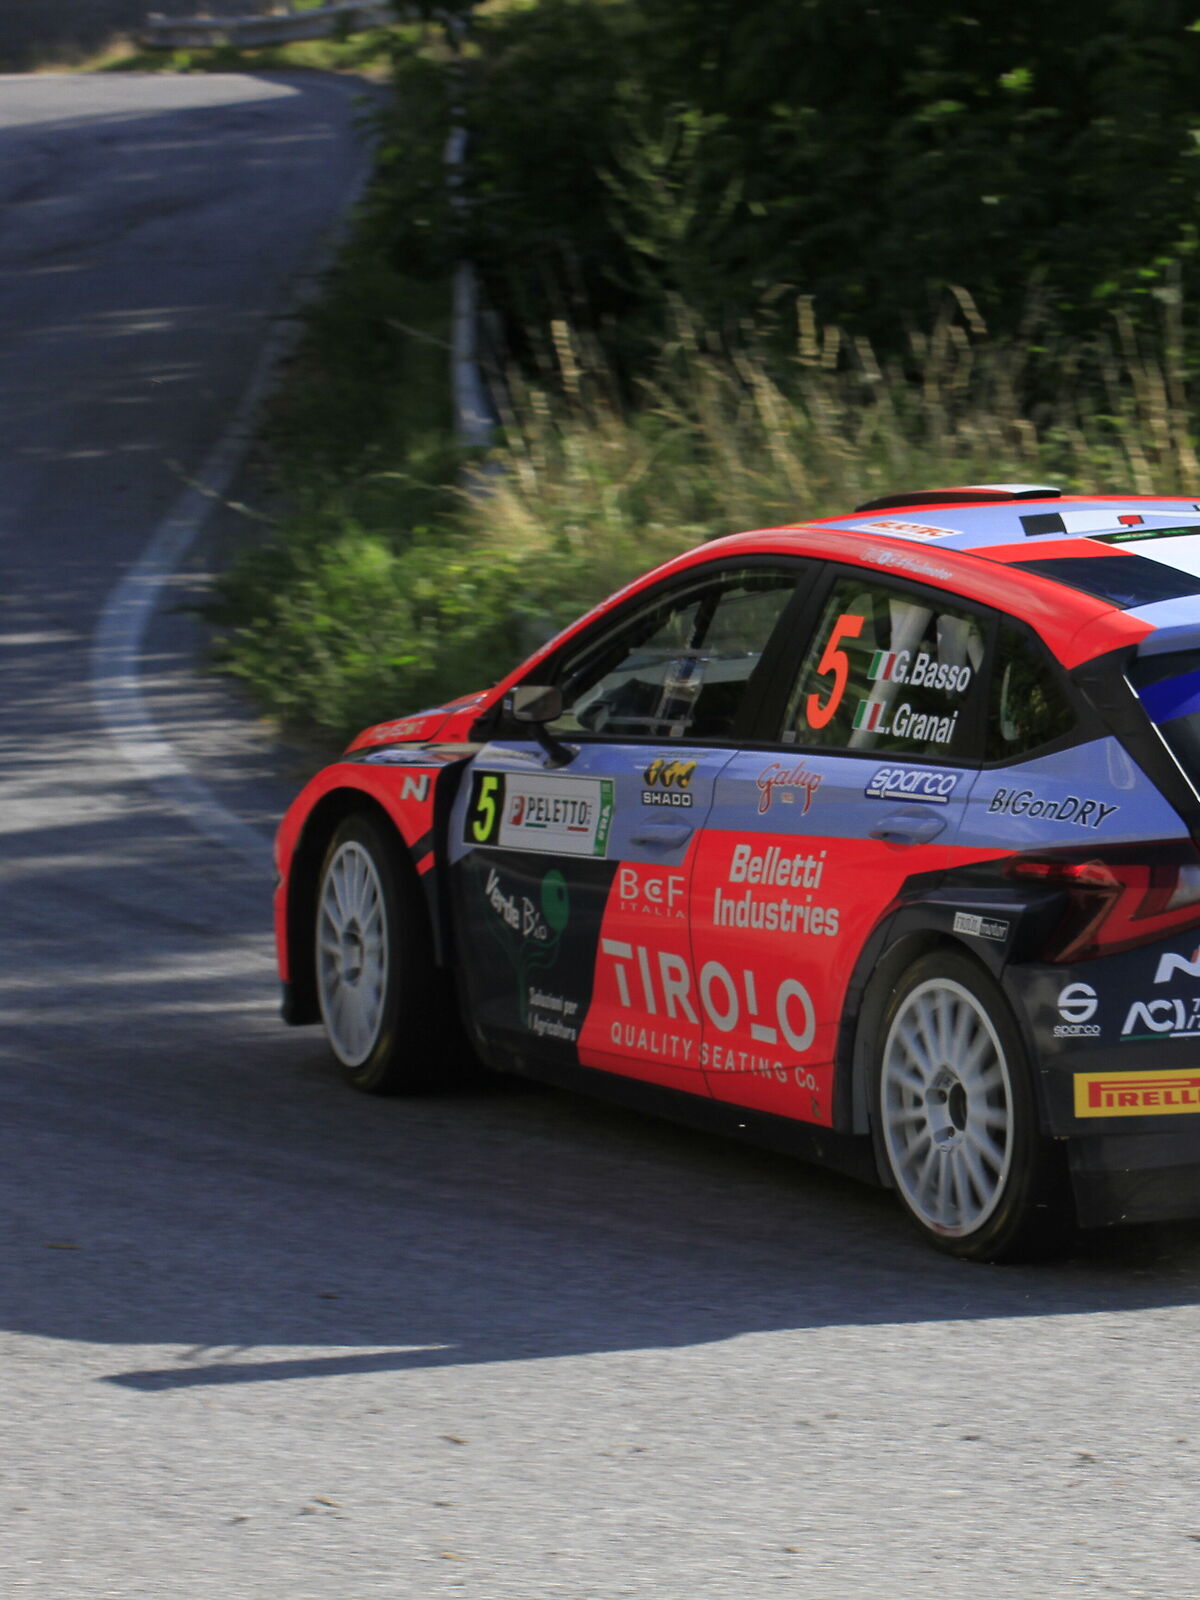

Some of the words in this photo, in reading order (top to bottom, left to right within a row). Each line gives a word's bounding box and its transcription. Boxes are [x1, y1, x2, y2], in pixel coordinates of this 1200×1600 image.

[806, 614, 865, 729] 5
[891, 650, 971, 692] G.Basso
[874, 701, 959, 743] L.Granai
[643, 791, 692, 806] SHADO
[868, 768, 957, 799] sparco
[473, 776, 498, 842] 5
[525, 797, 587, 825] PELETTO
[988, 788, 1119, 828] BIGonDRY
[729, 844, 827, 889] Belletti
[619, 902, 686, 919] ITALIA
[713, 888, 840, 936] Industries
[601, 938, 816, 1052] TIROLO
[1053, 1024, 1101, 1036] sparco
[611, 1022, 693, 1061] QUALITY
[699, 1043, 788, 1083] SEATING
[794, 1067, 820, 1091] Co.
